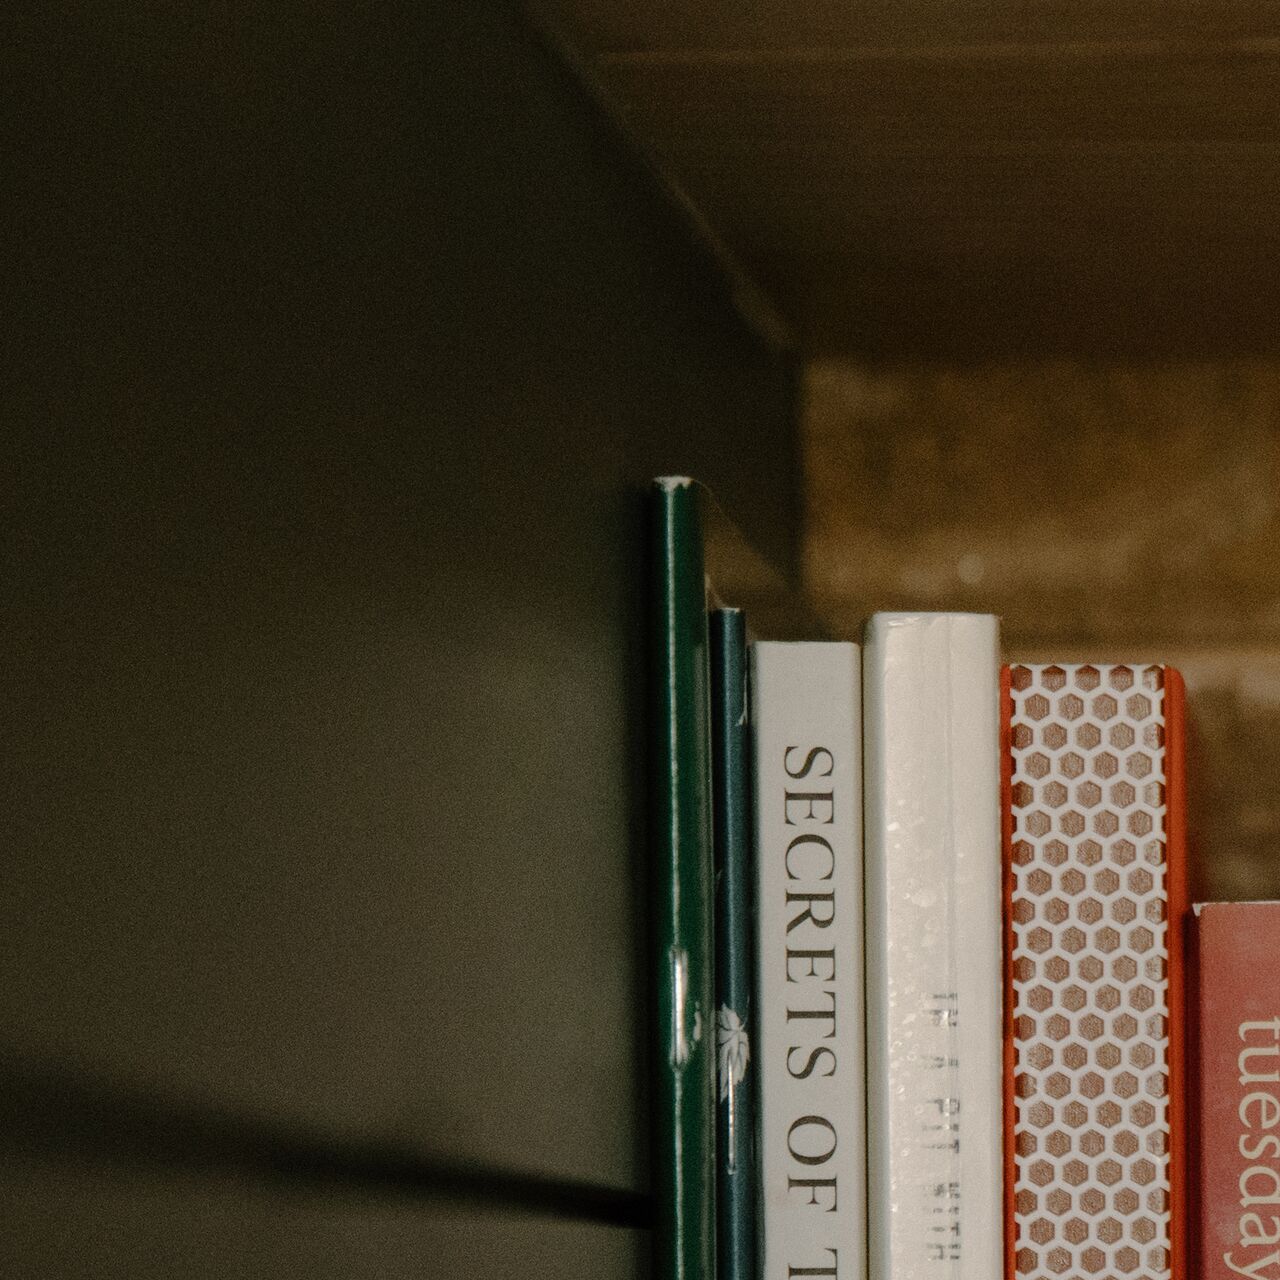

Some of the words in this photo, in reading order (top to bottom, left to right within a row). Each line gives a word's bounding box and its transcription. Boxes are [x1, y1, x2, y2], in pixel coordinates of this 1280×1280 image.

[783, 745, 836, 1080] SECRETS
[786, 1115, 837, 1211] OF
[922, 1182, 961, 1260] WITH
